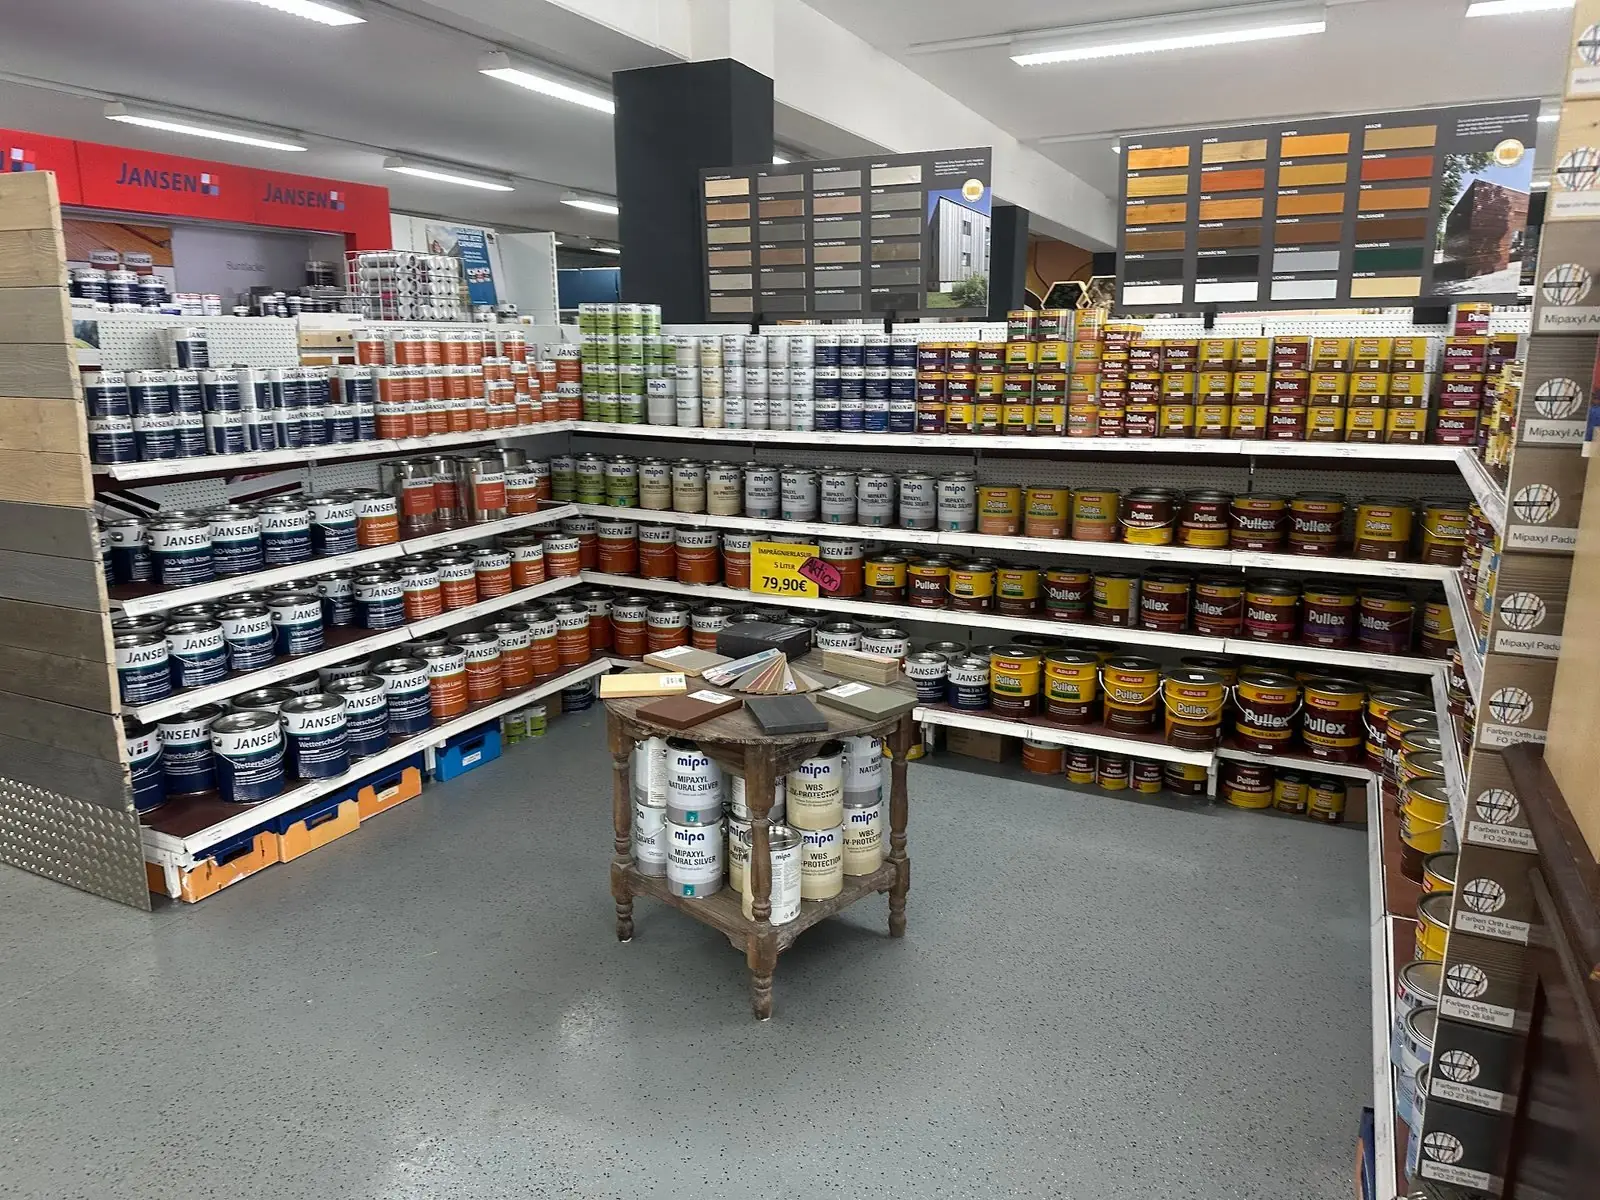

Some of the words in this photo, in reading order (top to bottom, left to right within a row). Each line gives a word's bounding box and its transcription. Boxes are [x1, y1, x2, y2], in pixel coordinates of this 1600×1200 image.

[116, 162, 198, 194] JANSEN
[263, 184, 328, 211] JANSEN
[1544, 314, 1587, 326] Mipaxyl
[1447, 348, 1473, 357] Pullex
[649, 381, 666, 391] mipa
[1447, 384, 1474, 394] Pullex
[95, 421, 129, 433] JANSEN
[1439, 420, 1464, 429] Pullex
[1529, 427, 1571, 440] Mipaxyl
[612, 466, 631, 477] mipa
[645, 467, 664, 478] mipa
[679, 470, 698, 480] mipa
[719, 472, 738, 482] mipa
[754, 474, 774, 485] mipa
[826, 479, 845, 490] mipa
[868, 480, 888, 490] mipa
[903, 482, 922, 492] mipa
[945, 484, 966, 495] mipa
[361, 502, 395, 514] JANSEN
[986, 501, 1008, 511] Pullex
[1032, 502, 1053, 512] Pullex
[1131, 511, 1154, 521] Pullex
[1194, 513, 1217, 522] Pullex
[266, 516, 305, 529] JANSEN
[1240, 516, 1275, 530] Pullex
[1295, 518, 1332, 533] Pullex
[1365, 521, 1391, 531] Pullex
[212, 525, 254, 538] JANSEN
[163, 535, 208, 548] JANSEN
[1512, 532, 1548, 545] Mipaxyl
[545, 541, 573, 553] JANSEN
[474, 558, 504, 569] JANSEN
[774, 562, 778, 570] 5
[441, 568, 473, 580] JANSEN
[803, 559, 839, 588] Aktion
[405, 575, 439, 588] JANSEN
[762, 576, 807, 592] 79,90€
[915, 579, 940, 590] Pullex
[369, 582, 402, 598] JANSEN
[1050, 588, 1081, 601] Pullex
[1142, 596, 1169, 611] Pullex
[1248, 607, 1278, 621] Pullex
[1309, 609, 1345, 625] Pullex
[818, 636, 848, 649] JANSEN
[863, 641, 893, 655] JANSEN
[1499, 638, 1534, 650] Mipaxyl
[910, 666, 941, 677] JANSEN
[998, 662, 1020, 670] ADLER
[956, 672, 986, 683] JANSEN
[1056, 668, 1078, 676] ADLER
[389, 673, 428, 691] JANSEN
[995, 675, 1022, 688] Pullex
[1120, 676, 1143, 684] ADLER
[1052, 680, 1080, 693] Pullex
[1116, 688, 1144, 701] Pullex
[1184, 690, 1207, 698] ADLER
[1261, 693, 1284, 701] ADLER
[1315, 698, 1338, 707] ADLER
[1178, 703, 1208, 715] Pullex
[299, 712, 343, 730] JANSEN
[1245, 708, 1288, 731] Pullex
[1304, 712, 1346, 735] Pullex
[1486, 726, 1513, 737] Farben
[234, 730, 280, 751] JANSEN
[677, 755, 709, 771] mipa
[799, 763, 830, 779] mipa
[677, 775, 709, 784] MIPAXYL
[1236, 775, 1260, 786] Pullex
[697, 781, 719, 792] SILVER
[805, 784, 823, 792] WBS
[852, 811, 878, 825] mipa
[859, 829, 874, 838] WBS
[1473, 824, 1499, 835] Farben
[674, 829, 705, 846] mipa
[803, 832, 834, 848] mipa
[1483, 833, 1495, 841] FO
[674, 848, 705, 858] MIPAXYL
[775, 853, 791, 861] mipa
[694, 855, 717, 866] SILVER
[801, 855, 841, 869] -PROTECTION
[1461, 914, 1486, 924] Farben
[1473, 923, 1485, 931] FO
[1446, 999, 1470, 1010] Farben
[1459, 1008, 1470, 1016] FO
[1435, 1081, 1460, 1092] Farben
